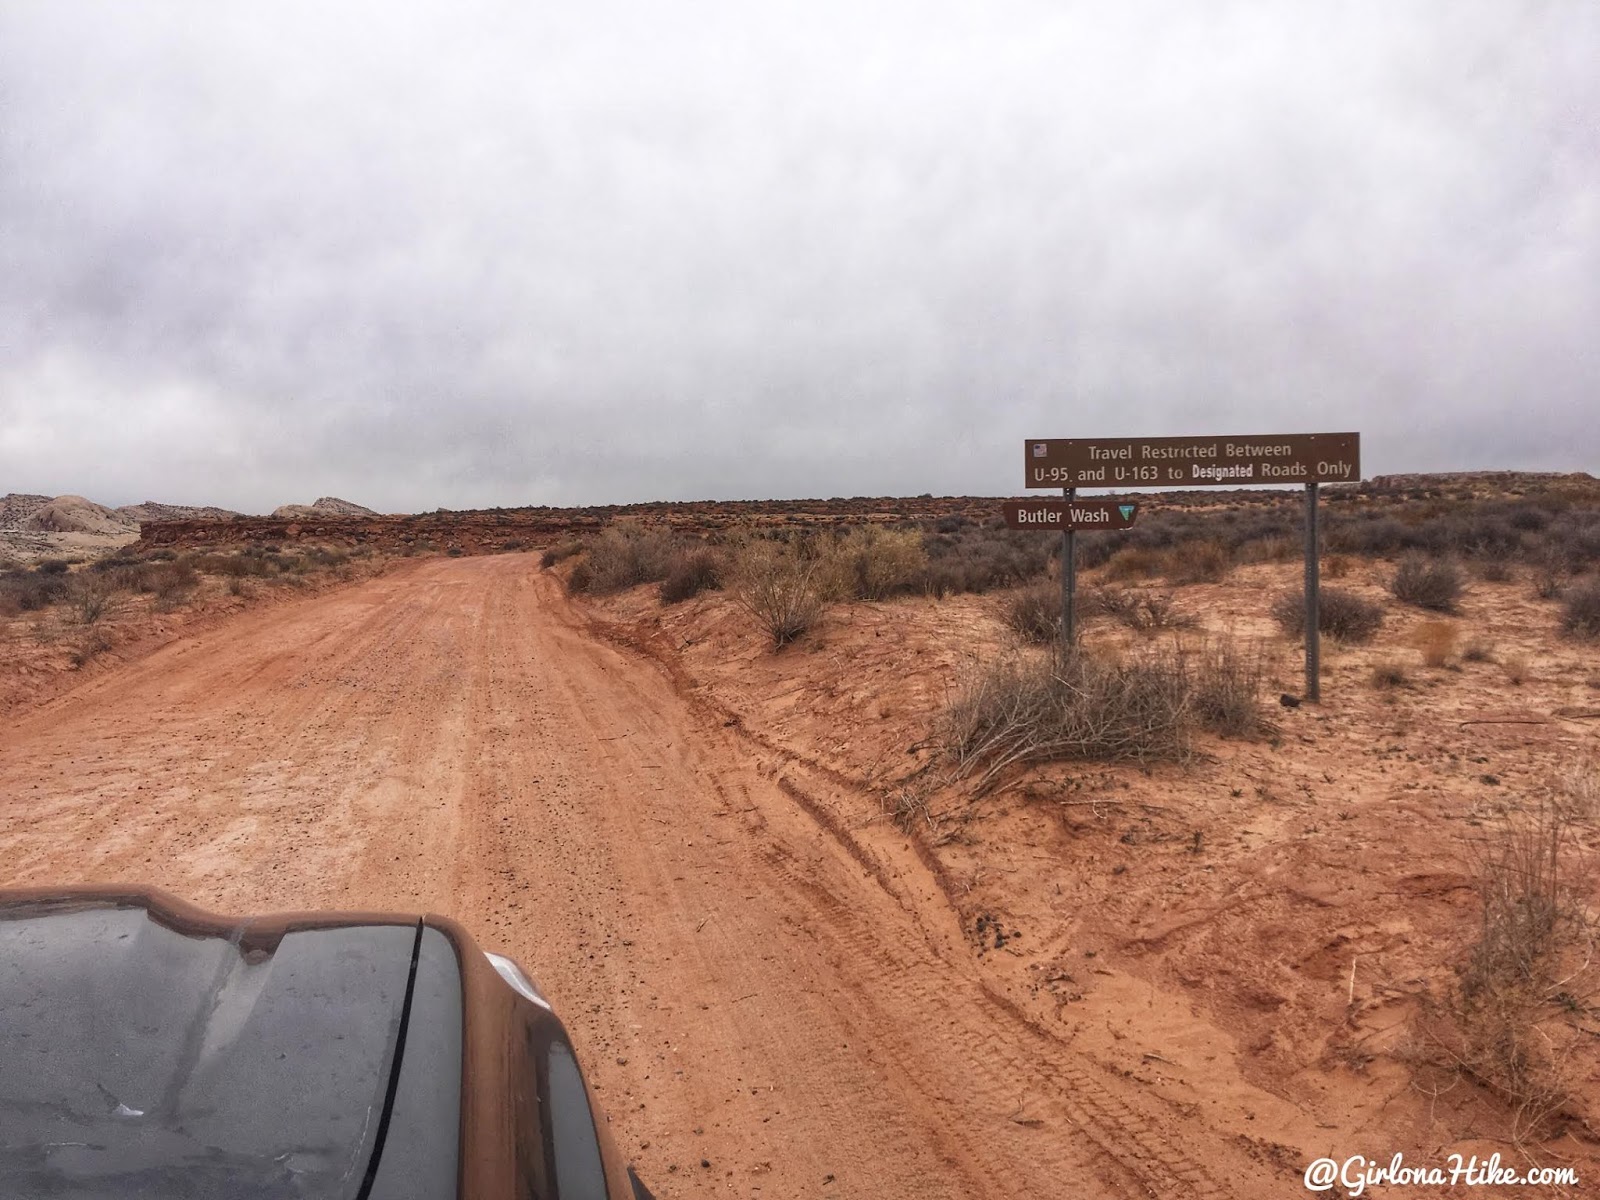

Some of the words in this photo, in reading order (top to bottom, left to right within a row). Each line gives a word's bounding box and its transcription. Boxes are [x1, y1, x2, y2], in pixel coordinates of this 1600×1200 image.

[1088, 445, 1132, 460] Travel
[1142, 443, 1217, 459] Restricted
[1226, 443, 1292, 457] Between
[1034, 467, 1069, 482] U-95
[1078, 466, 1105, 481] and
[1115, 466, 1158, 480] U-163
[1168, 467, 1183, 480] to
[1192, 464, 1253, 481] Designated
[1261, 462, 1307, 477] Roads
[1317, 460, 1352, 477] Only
[1018, 509, 1062, 523] Butler
[1070, 508, 1109, 523] Wash
